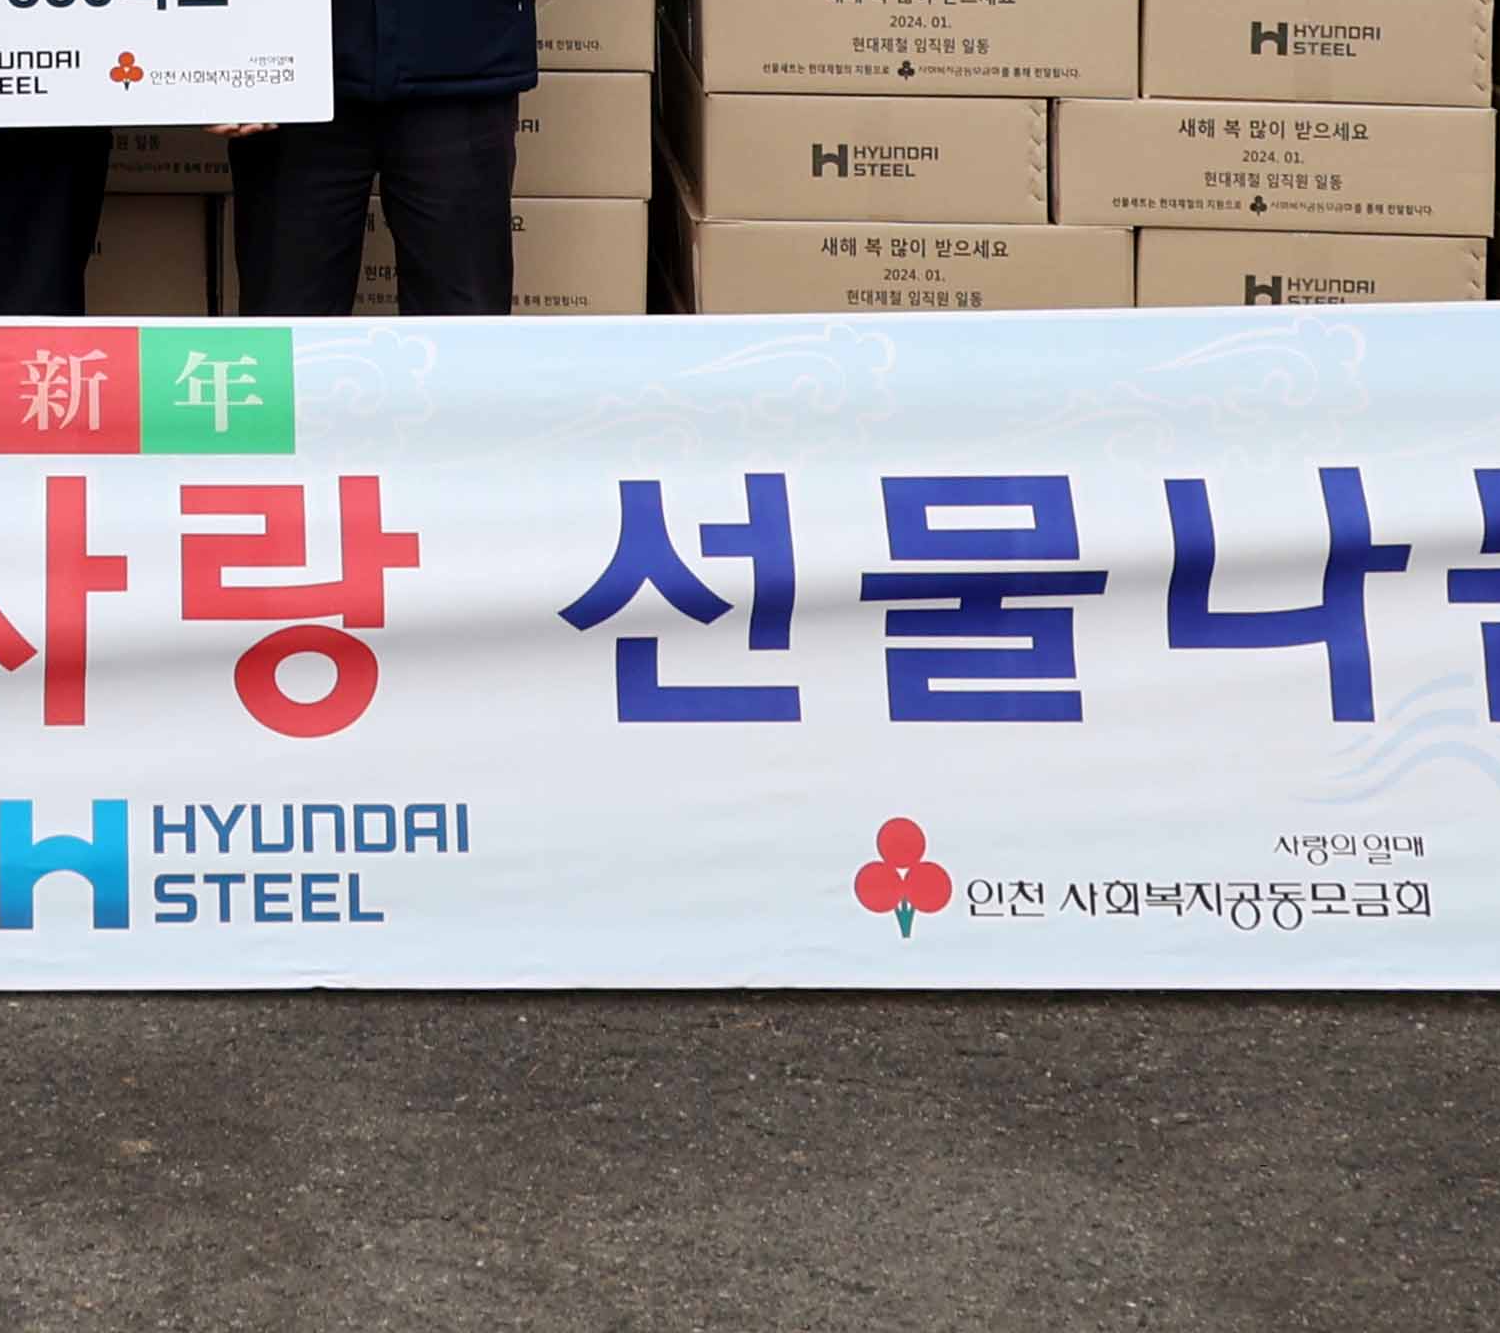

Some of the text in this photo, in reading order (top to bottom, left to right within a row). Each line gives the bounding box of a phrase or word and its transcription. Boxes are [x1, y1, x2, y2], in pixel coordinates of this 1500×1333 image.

[890, 16, 951, 28] 2024. 01.
[1294, 25, 1380, 40] HYUNDAI
[853, 37, 989, 54] 현대제철 임직원 일동
[1294, 42, 1356, 56] STEEL
[150, 69, 294, 87] 인천 사회복지공동모금회
[154, 804, 468, 853] HYUNDAI
[1275, 834, 1423, 866] 사랑의 열매
[154, 873, 384, 922] STEEL
[968, 881, 1430, 929] 인천 사회복지공동모금회
